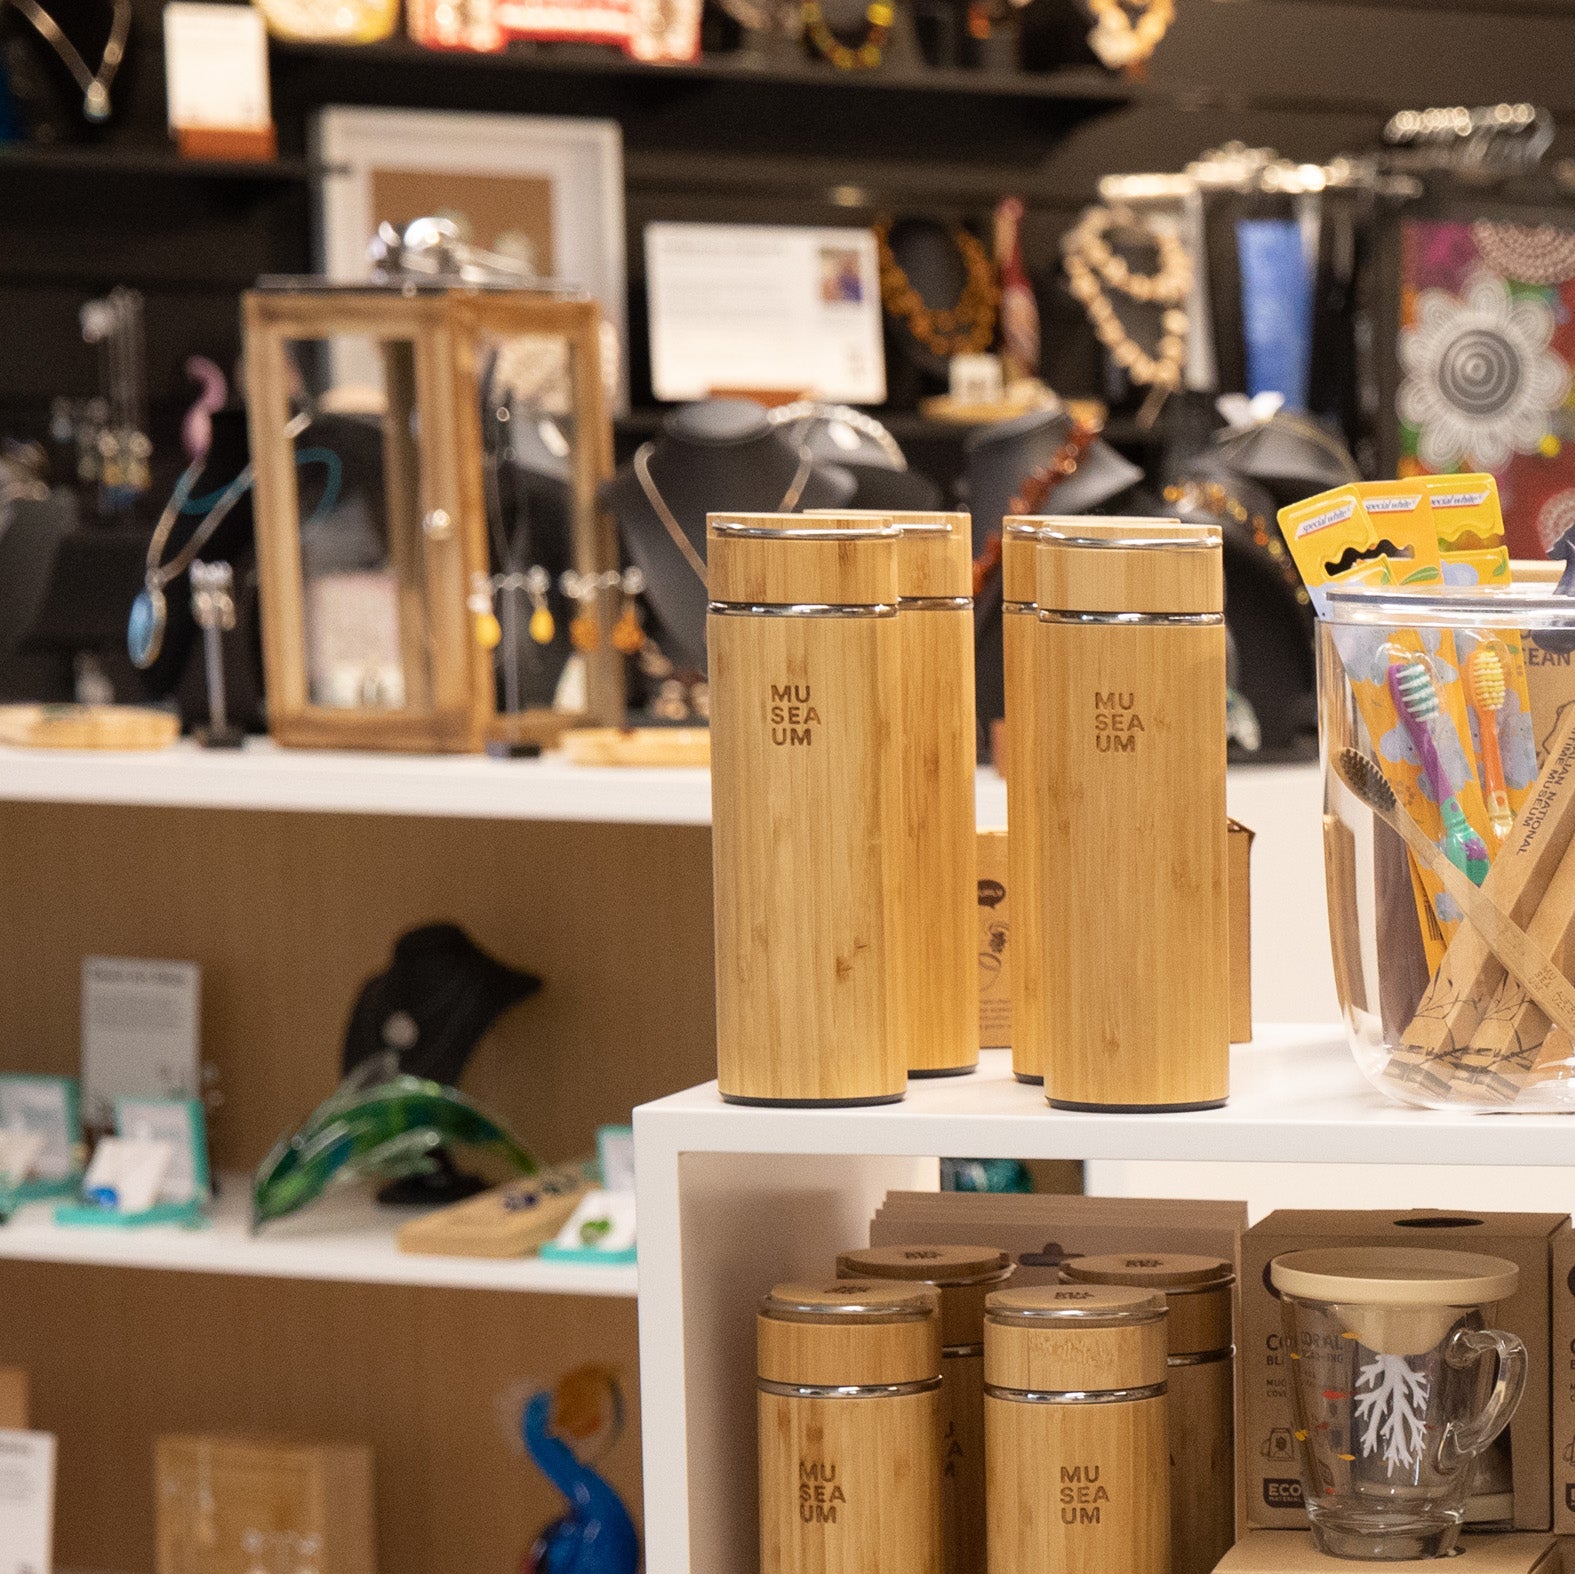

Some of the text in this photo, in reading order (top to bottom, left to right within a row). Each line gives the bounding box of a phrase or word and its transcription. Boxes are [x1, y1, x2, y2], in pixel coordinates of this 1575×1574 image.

[771, 684, 811, 704] MU
[1094, 692, 1134, 711] MU
[771, 705, 821, 726] SEA
[1094, 713, 1145, 733] SEA
[772, 727, 811, 747] UM
[1096, 734, 1135, 753] UM
[1522, 770, 1557, 827] MUSEUM
[1516, 791, 1557, 855] NATIONAL
[799, 1461, 836, 1482] MU
[1059, 1466, 1100, 1484] MU
[798, 1482, 846, 1503] SEA
[1059, 1485, 1110, 1504] SEA
[799, 1504, 837, 1525] UM
[1061, 1506, 1101, 1525] UM
